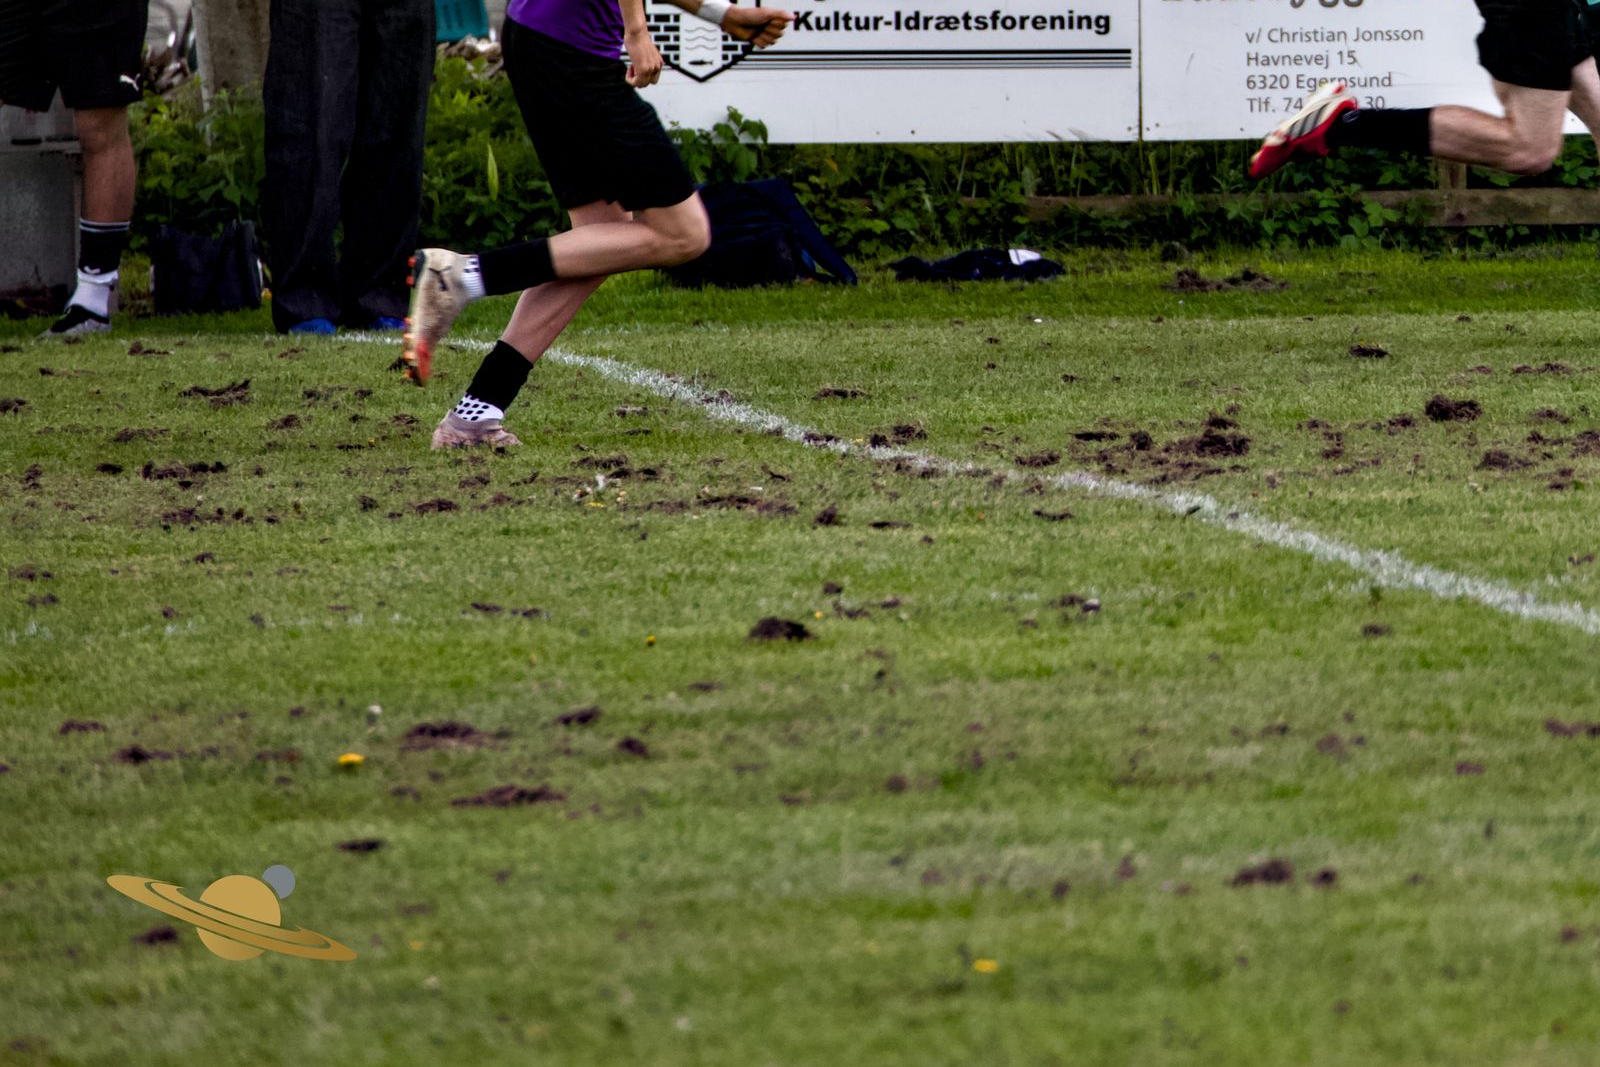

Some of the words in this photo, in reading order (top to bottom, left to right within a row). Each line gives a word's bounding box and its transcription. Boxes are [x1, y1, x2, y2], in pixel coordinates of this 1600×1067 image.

[792, 10, 1111, 35] Kultur-Idrætsforening
[1267, 26, 1347, 43] Christian
[1353, 26, 1424, 42] Jonsson
[1246, 51, 1330, 69] Havnevej
[1336, 50, 1357, 65] 15
[1246, 74, 1290, 90] 6320
[1247, 97, 1276, 113] Tlf.
